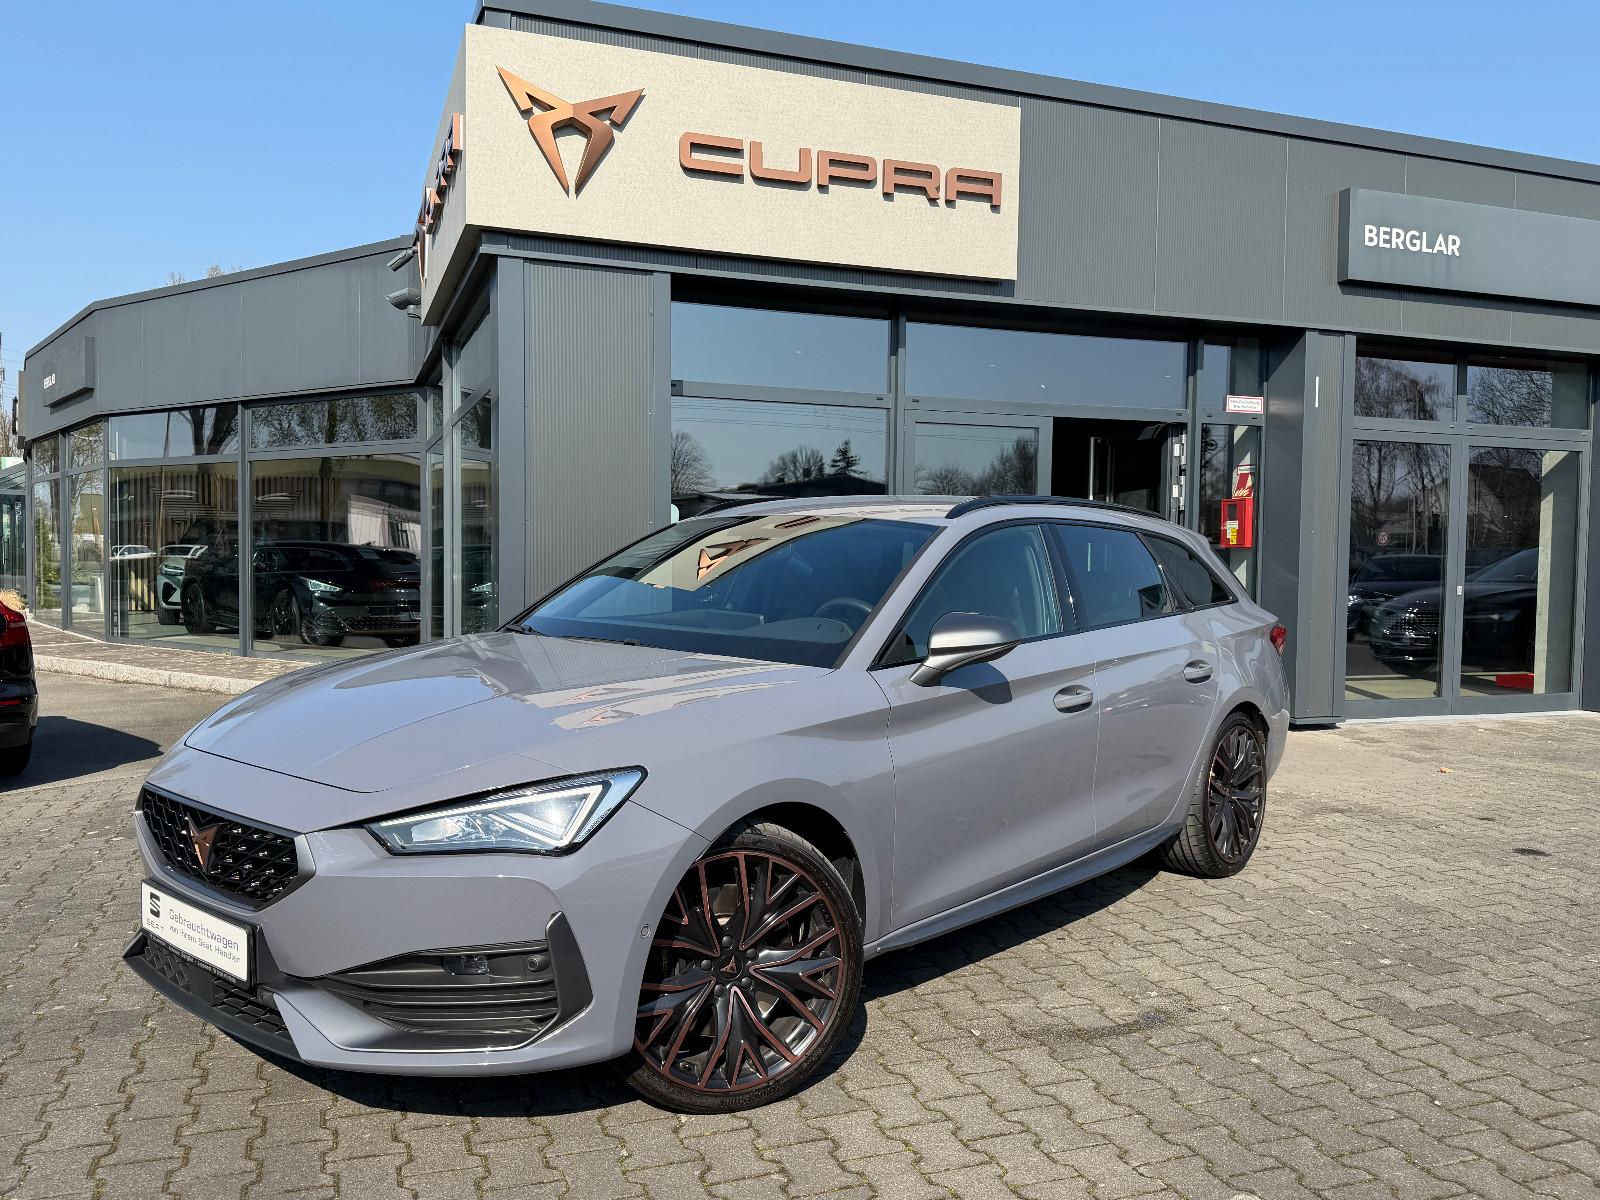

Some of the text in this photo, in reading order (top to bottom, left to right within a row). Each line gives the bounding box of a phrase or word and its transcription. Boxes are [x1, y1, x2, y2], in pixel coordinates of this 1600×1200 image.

[679, 132, 1002, 207] CUPRA
[1364, 224, 1461, 257] BERGLAR
[169, 908, 240, 952] Gebrauchtwagen
[198, 937, 213, 952] Seat
